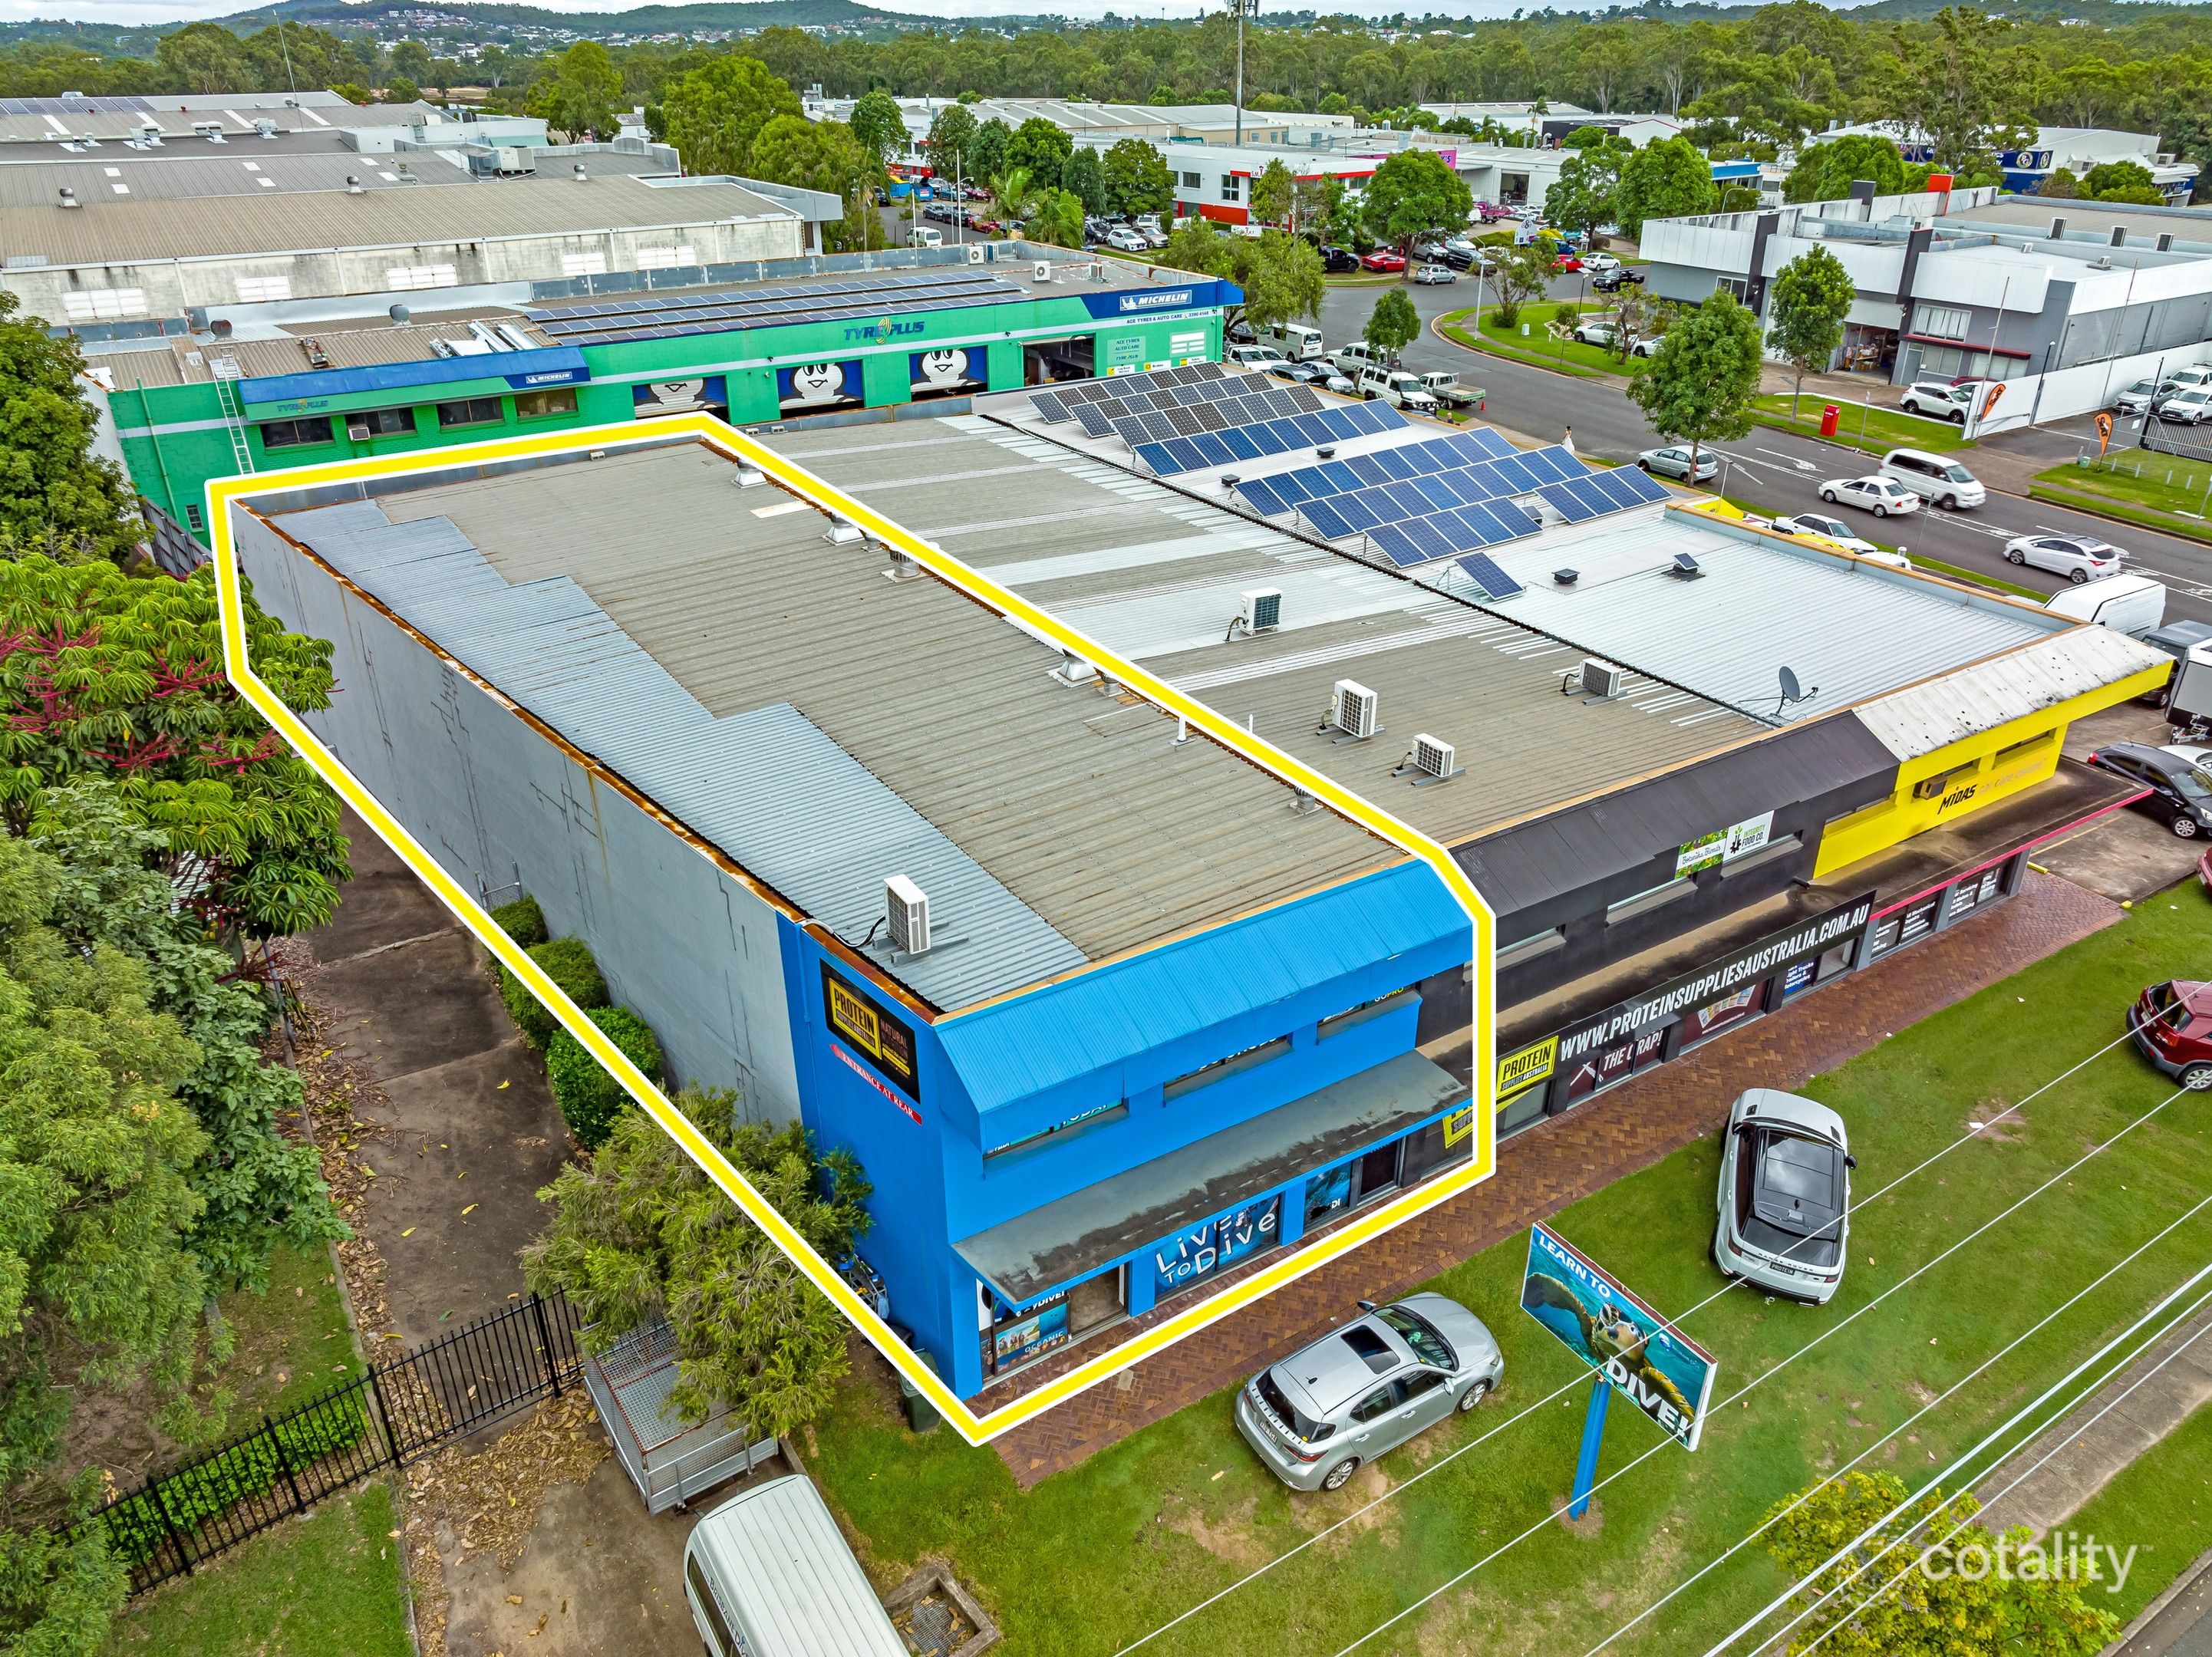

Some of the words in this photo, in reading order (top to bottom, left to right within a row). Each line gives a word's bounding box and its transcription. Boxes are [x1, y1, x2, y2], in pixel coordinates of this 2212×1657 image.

[1139, 293, 1188, 305] MICHELIN
[1742, 835, 1755, 847] FOOD
[1755, 832, 1764, 842] CO.
[1743, 824, 1766, 838] INTEGRITY
[1561, 903, 1870, 1062] WWW.PROTEINSUPPLIESAUSTRALIA.COM.AU
[834, 987, 875, 1036] PROTEIN
[881, 1019, 908, 1049] NATURAL
[1503, 1044, 1552, 1081] PROTEIN
[1604, 1050, 1624, 1072] THE
[842, 1053, 882, 1092] ENTRANCE
[882, 1088, 892, 1102] AT
[892, 1095, 914, 1119] REAR
[1502, 1074, 1523, 1090] SUPPLIES
[1523, 1064, 1548, 1080] AUSTRALIA
[1453, 1110, 1472, 1132] SUPP
[1540, 1235, 1587, 1281] LEARN
[1591, 1274, 1611, 1299] TO
[1771, 1263, 1794, 1275] PROTEIN
[1788, 1263, 1814, 1272] ROVER
[1606, 1355, 1689, 1438] DIVE!
